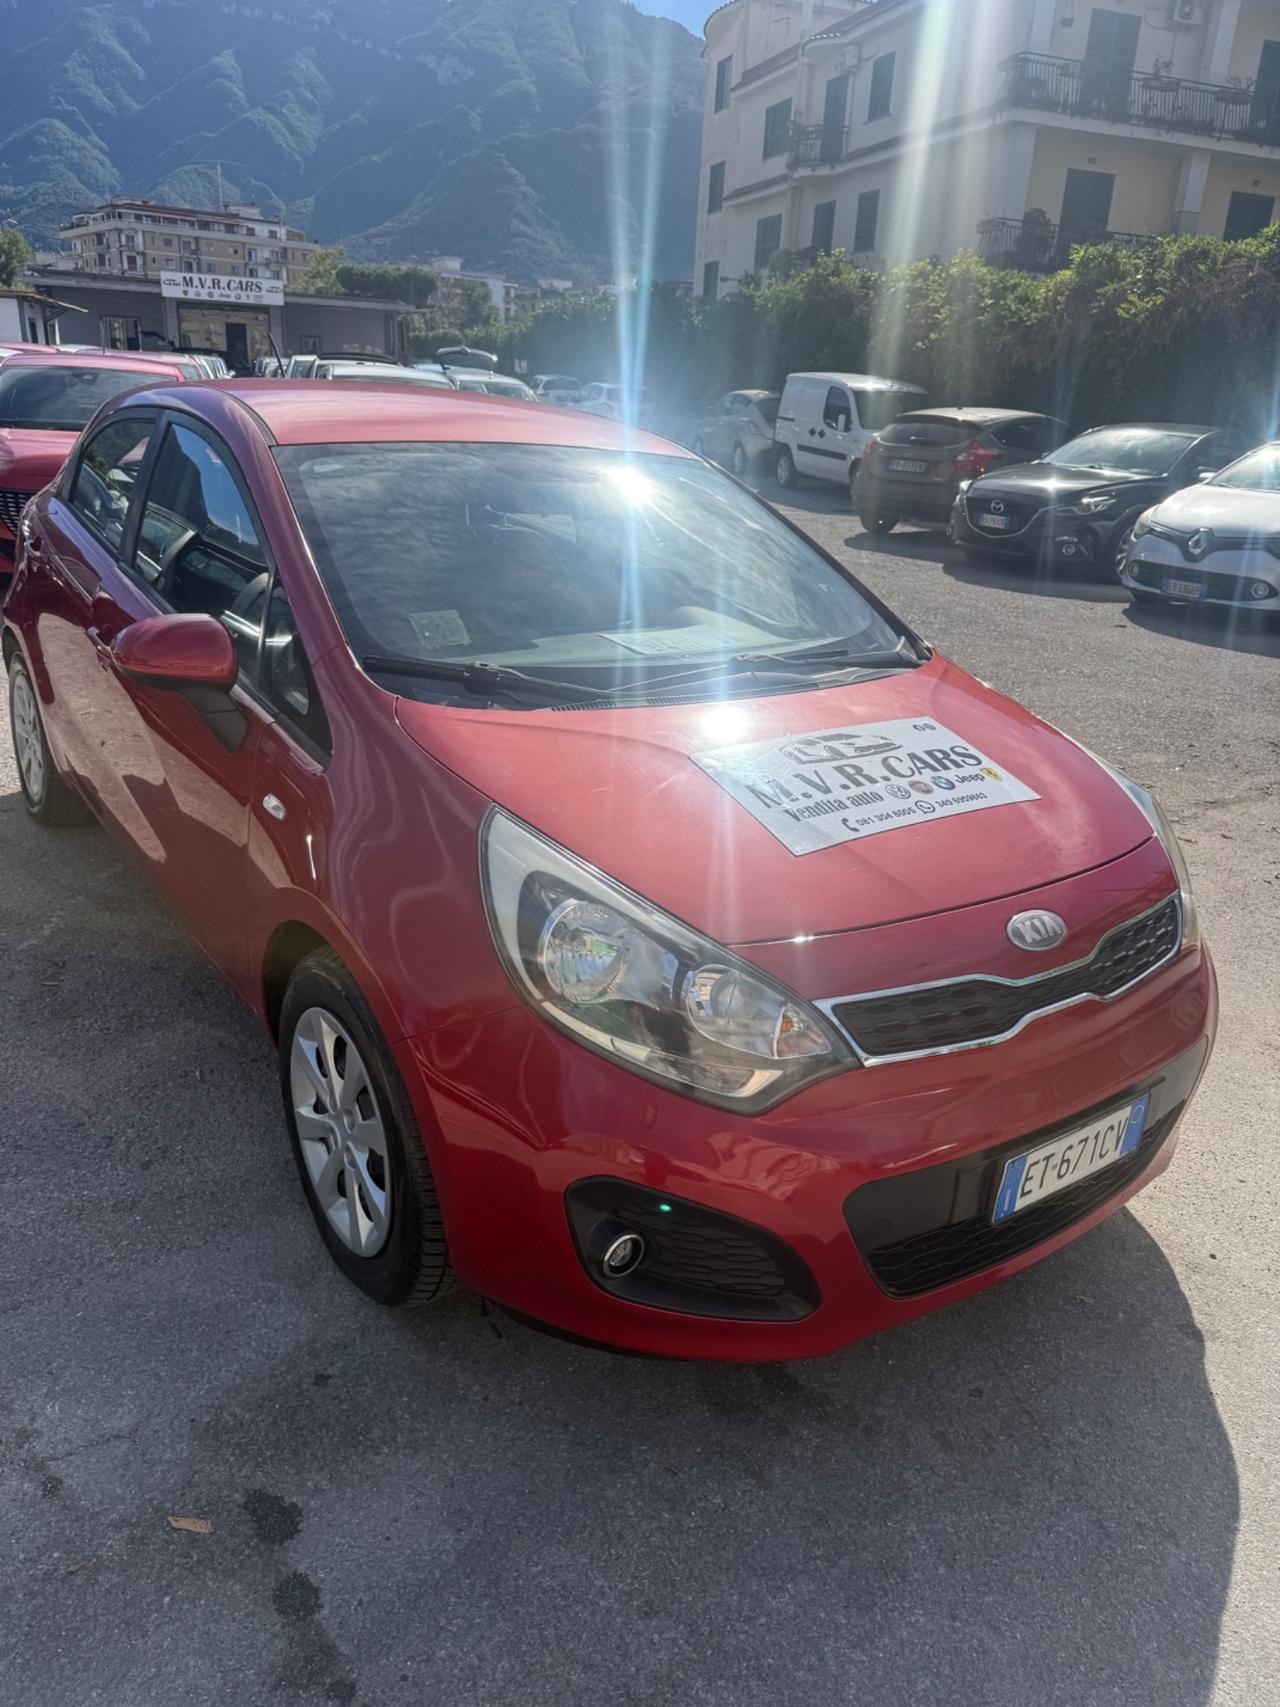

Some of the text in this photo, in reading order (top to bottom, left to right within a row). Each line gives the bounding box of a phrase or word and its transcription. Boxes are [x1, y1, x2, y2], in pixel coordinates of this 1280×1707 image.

[954, 772, 986, 785] Jeep
[850, 791, 885, 808] auto
[1016, 915, 1062, 943] KIA
